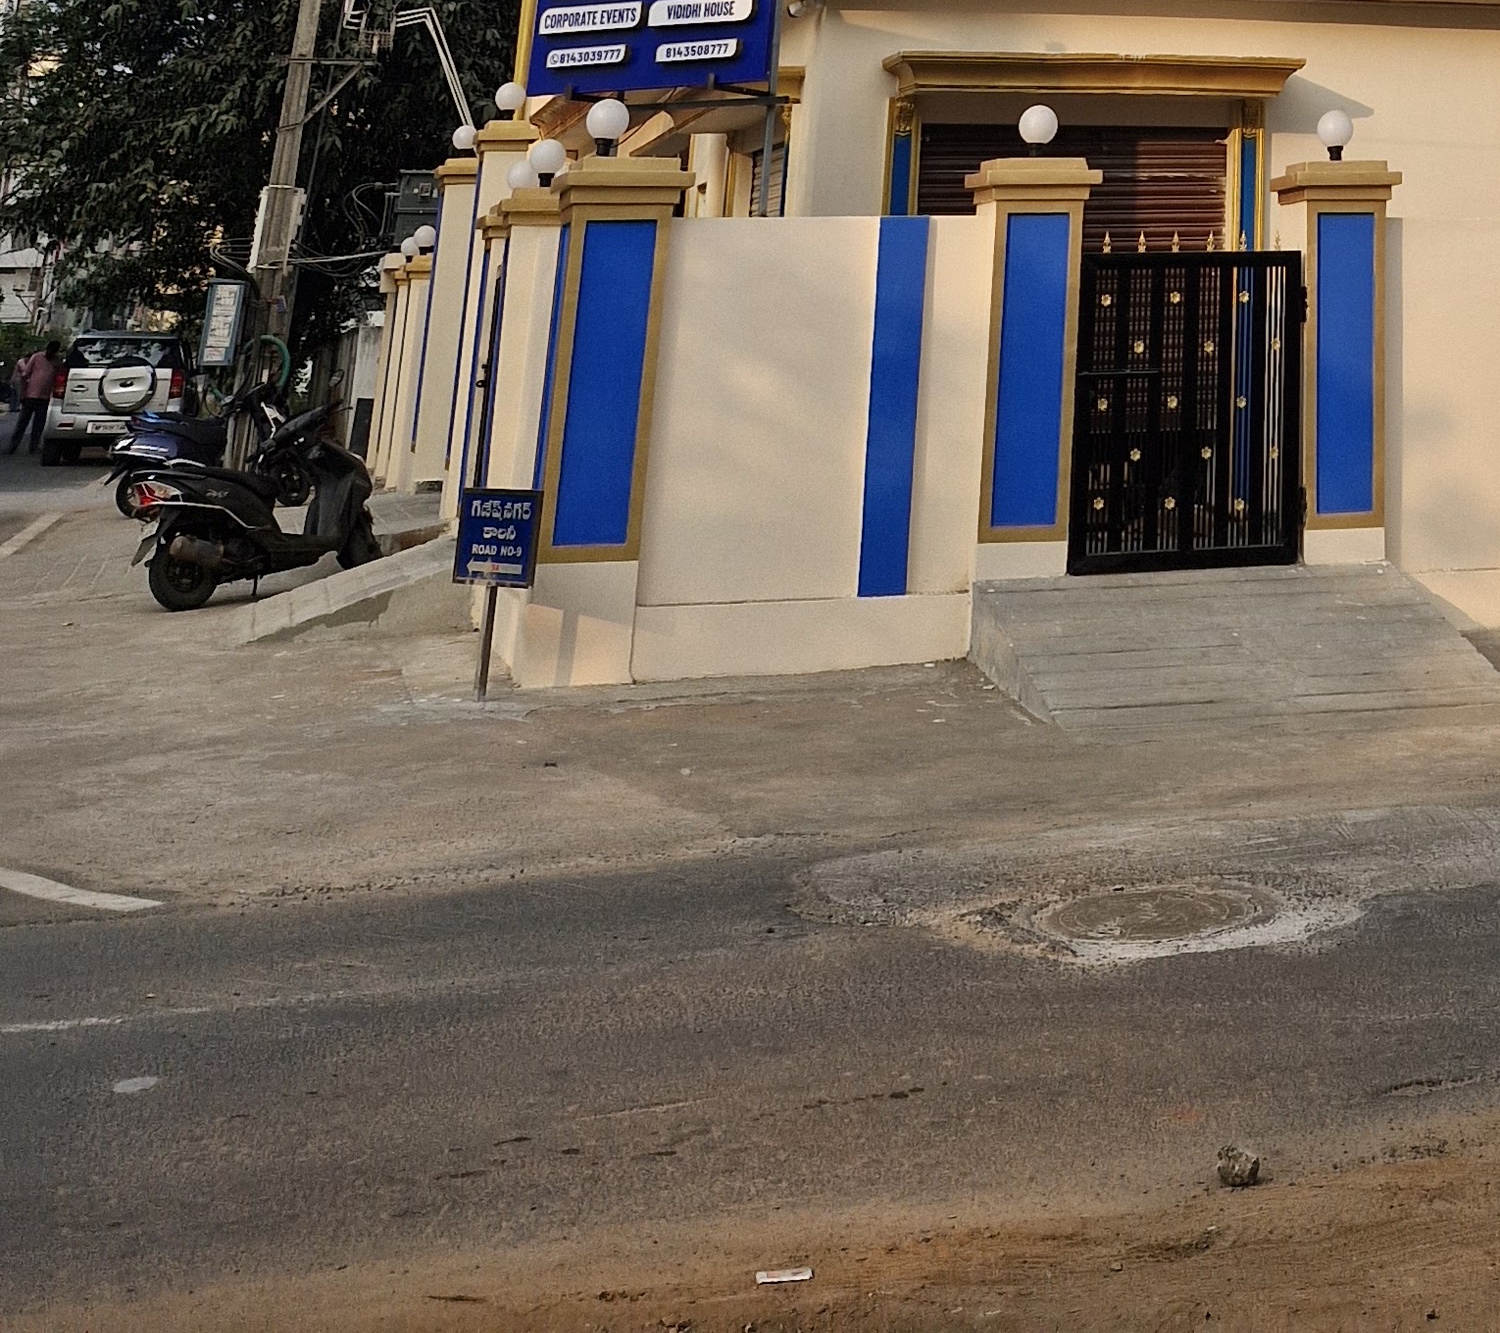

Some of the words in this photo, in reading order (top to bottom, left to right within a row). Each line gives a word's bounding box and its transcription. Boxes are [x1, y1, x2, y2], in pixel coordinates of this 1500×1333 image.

[667, 3, 702, 20] VIDIDHI
[703, 0, 736, 17] HOUSE
[544, 11, 598, 29] CORPORATE
[600, 7, 637, 24] EVENTS
[560, 49, 621, 64] 8143039777
[666, 43, 729, 58] 8143508777
[471, 544, 497, 555] ROAD
[500, 545, 522, 557] NO-9
